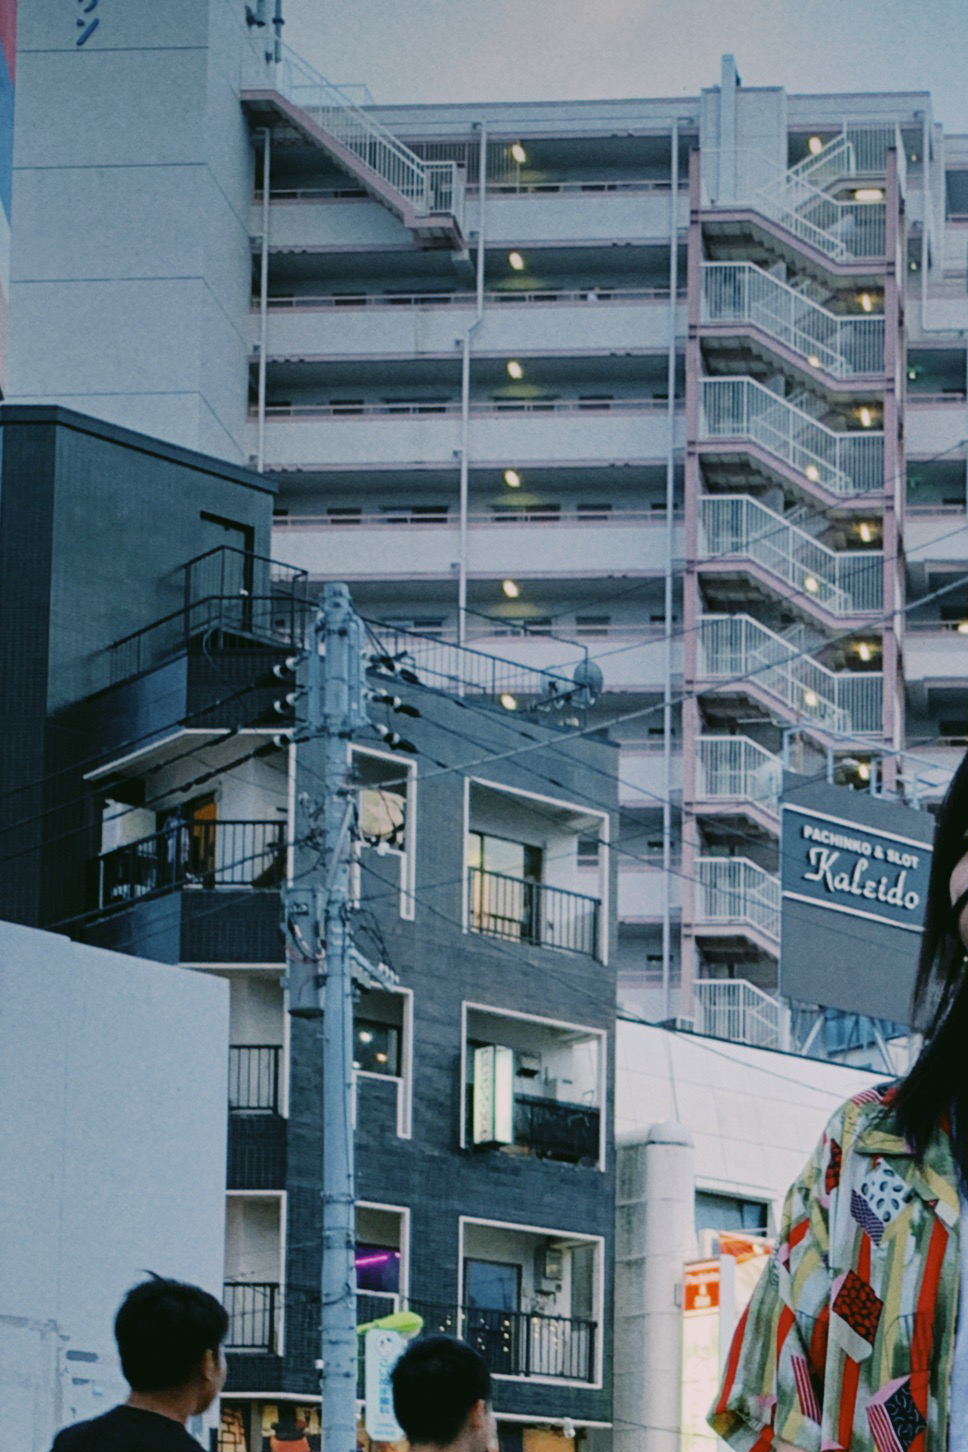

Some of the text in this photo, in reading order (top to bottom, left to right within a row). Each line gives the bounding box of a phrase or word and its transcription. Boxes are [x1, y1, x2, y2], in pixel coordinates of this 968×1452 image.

[803, 825, 920, 870] PACHINKO & SLOT
[804, 847, 920, 910] Kaleido
